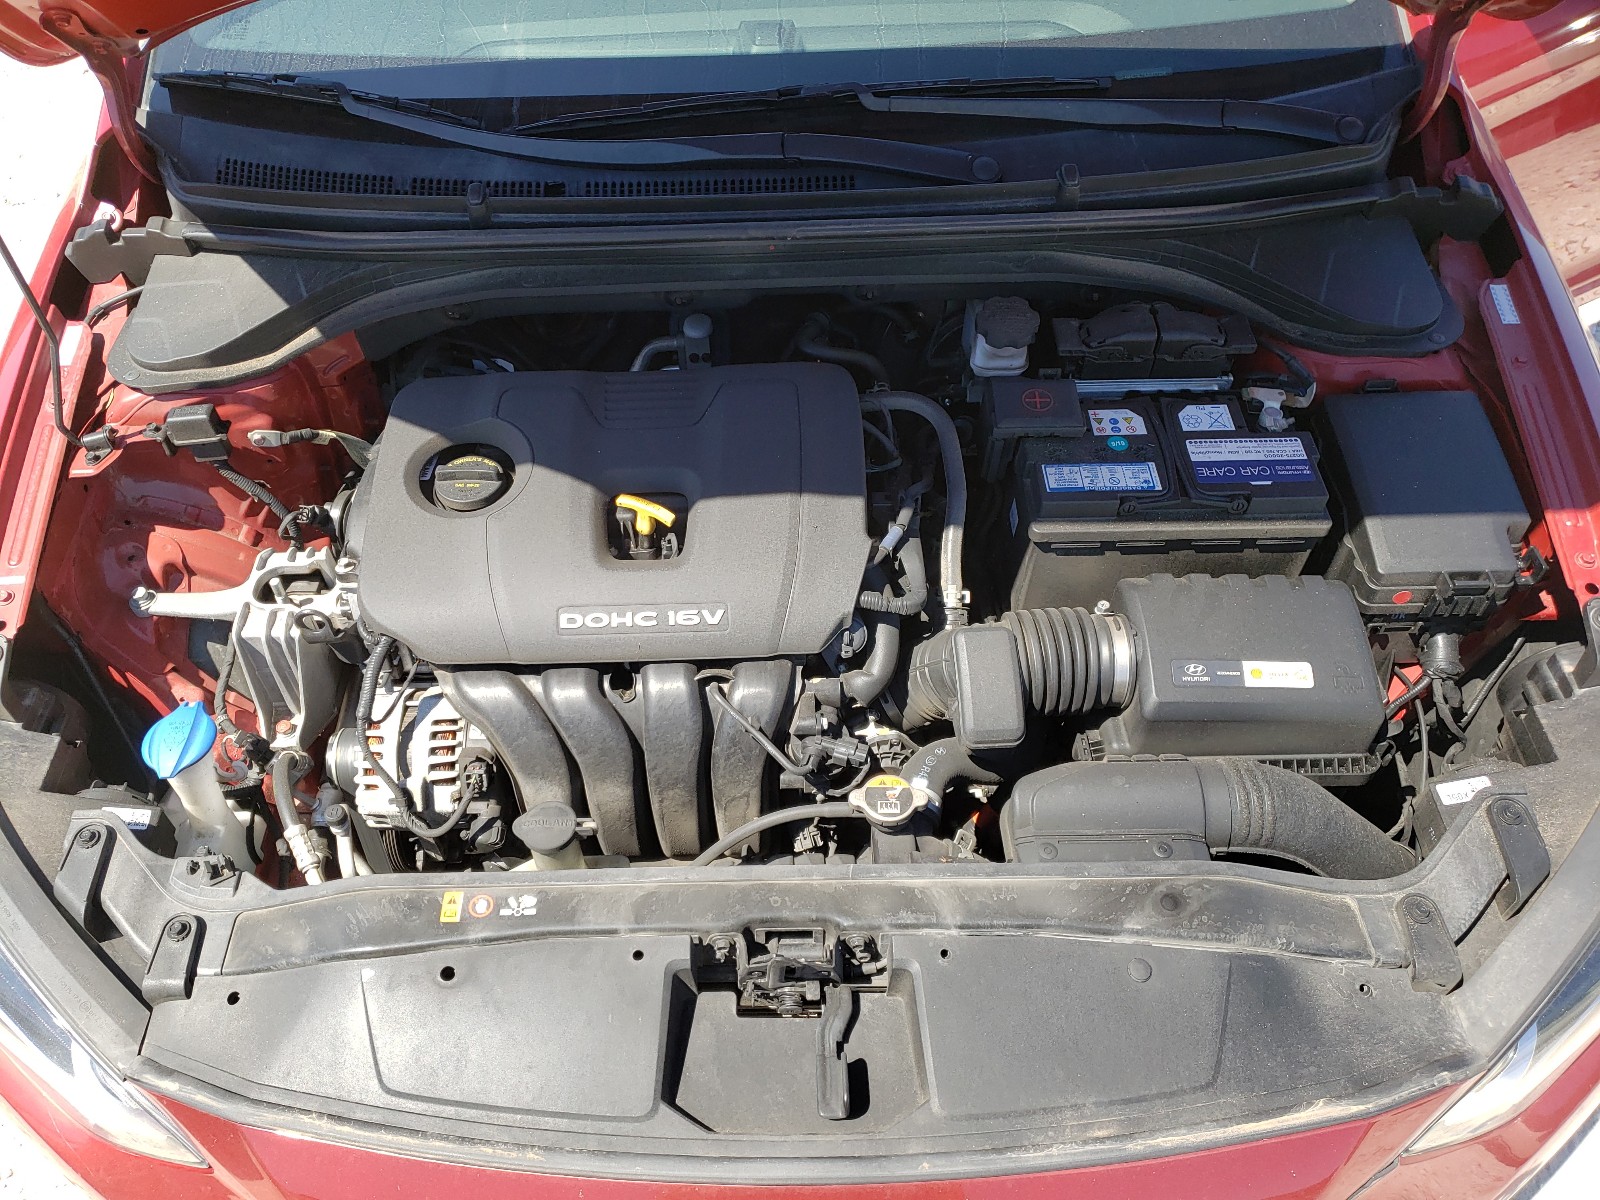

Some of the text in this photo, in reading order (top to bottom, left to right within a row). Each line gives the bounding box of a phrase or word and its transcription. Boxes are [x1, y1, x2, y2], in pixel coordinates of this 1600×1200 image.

[1197, 466, 1270, 476] CAR CARE
[559, 609, 726, 629] DOHC 16V
[523, 819, 574, 828] COOLANT
